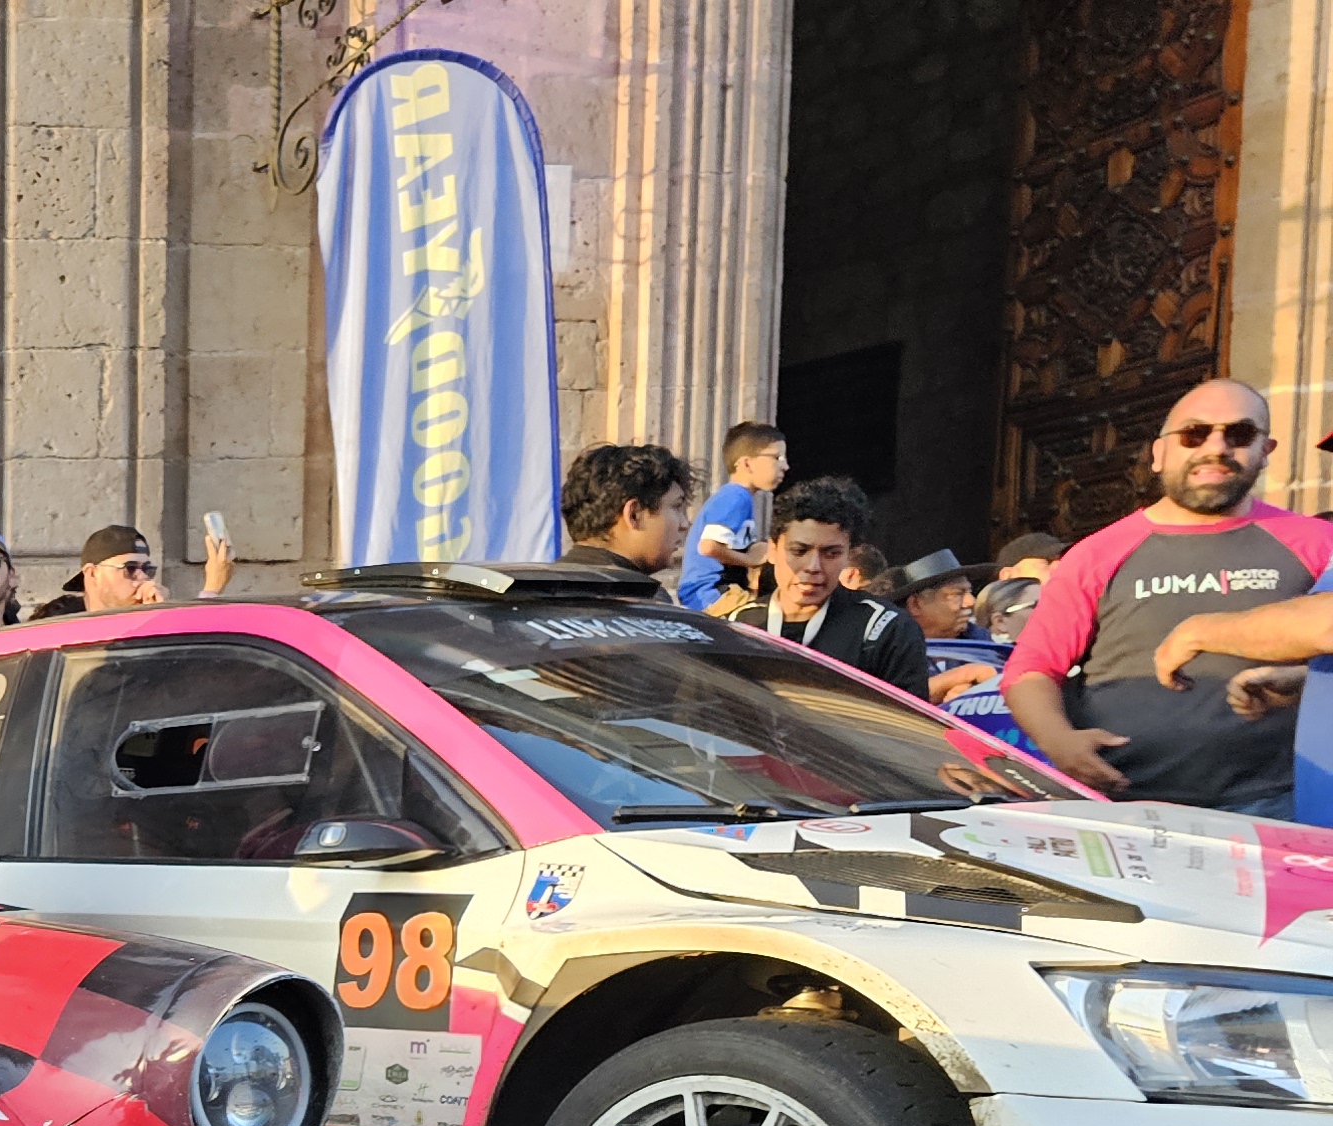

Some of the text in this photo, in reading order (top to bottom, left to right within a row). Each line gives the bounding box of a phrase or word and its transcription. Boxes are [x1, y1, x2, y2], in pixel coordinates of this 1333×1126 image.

[1226, 568, 1280, 581] MOTOR
[1135, 572, 1222, 600] LUMA
[1229, 579, 1278, 591] SPORT
[336, 910, 455, 1011] 98
